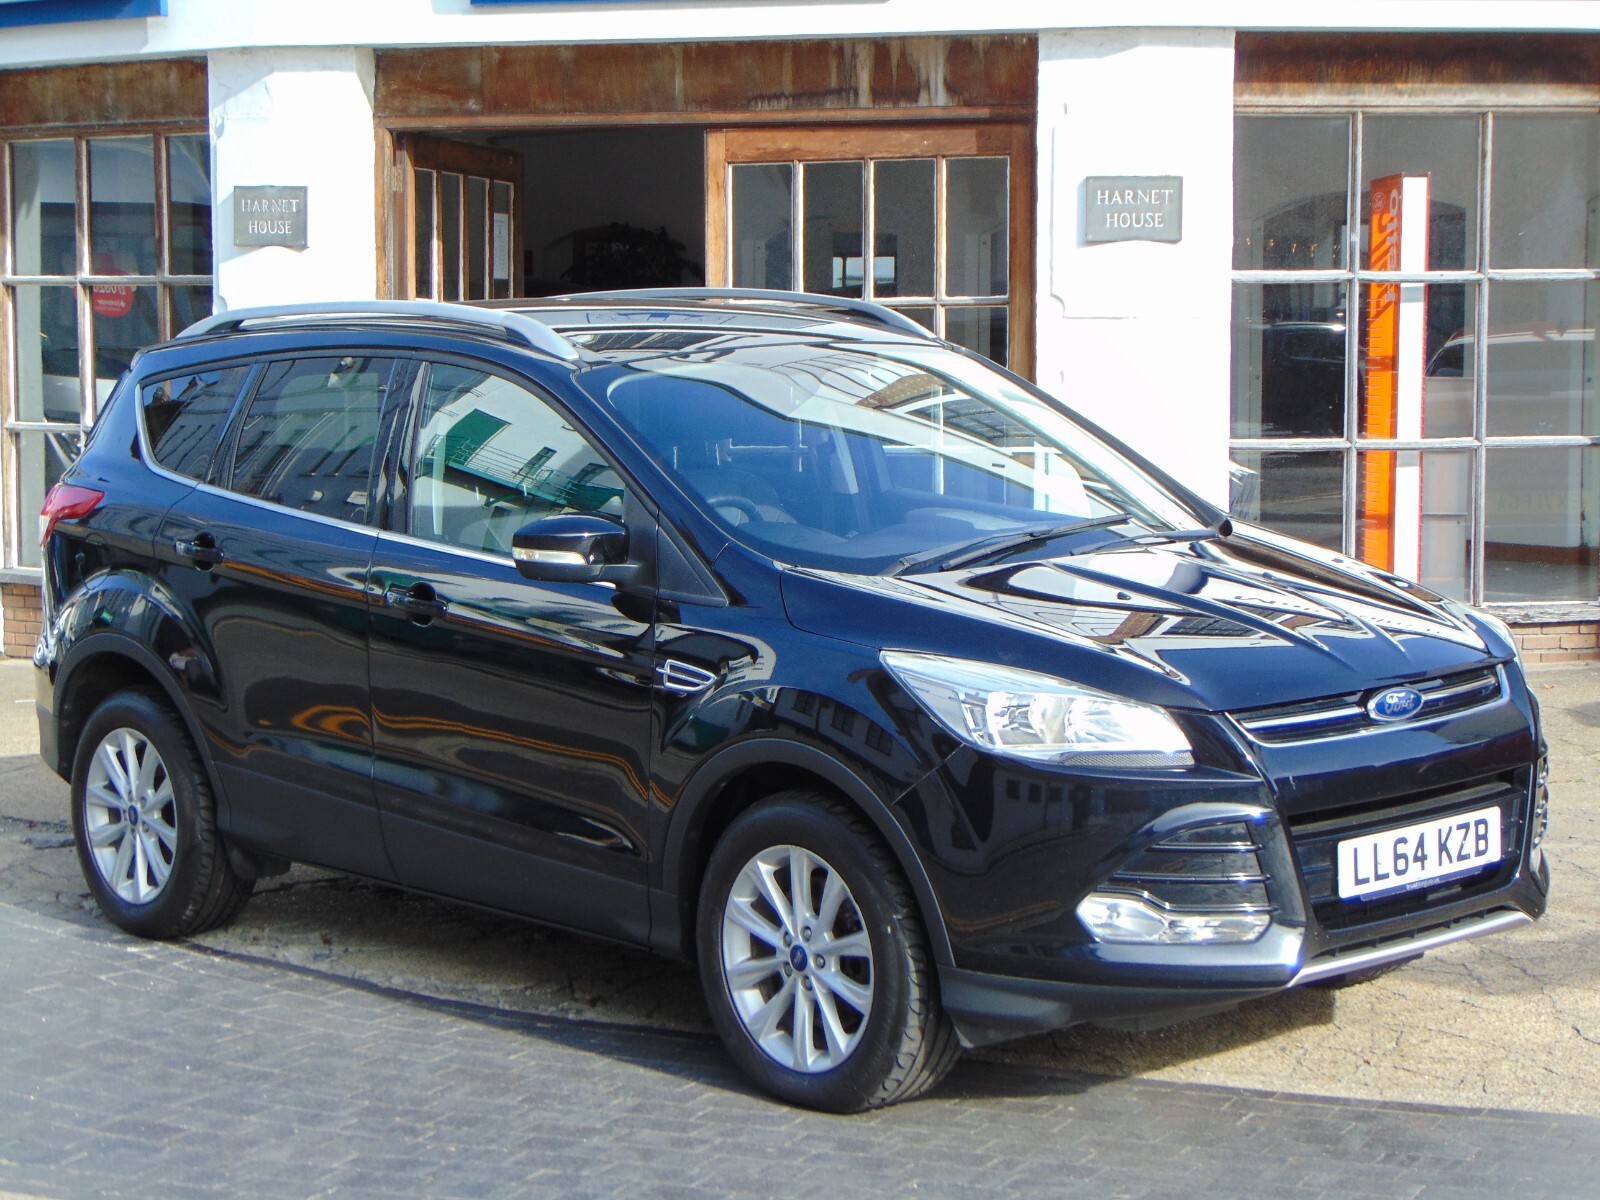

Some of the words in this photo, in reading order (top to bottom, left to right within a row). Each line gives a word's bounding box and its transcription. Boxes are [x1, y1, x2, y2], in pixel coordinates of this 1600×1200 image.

[1096, 189, 1174, 205] HARNET
[241, 199, 300, 213] HARNET
[248, 220, 292, 234] HOUSE
[1106, 212, 1164, 228] HOUSE
[1384, 691, 1416, 715] Ford
[1353, 831, 1428, 887] LL64
[1437, 817, 1489, 867] KZB
